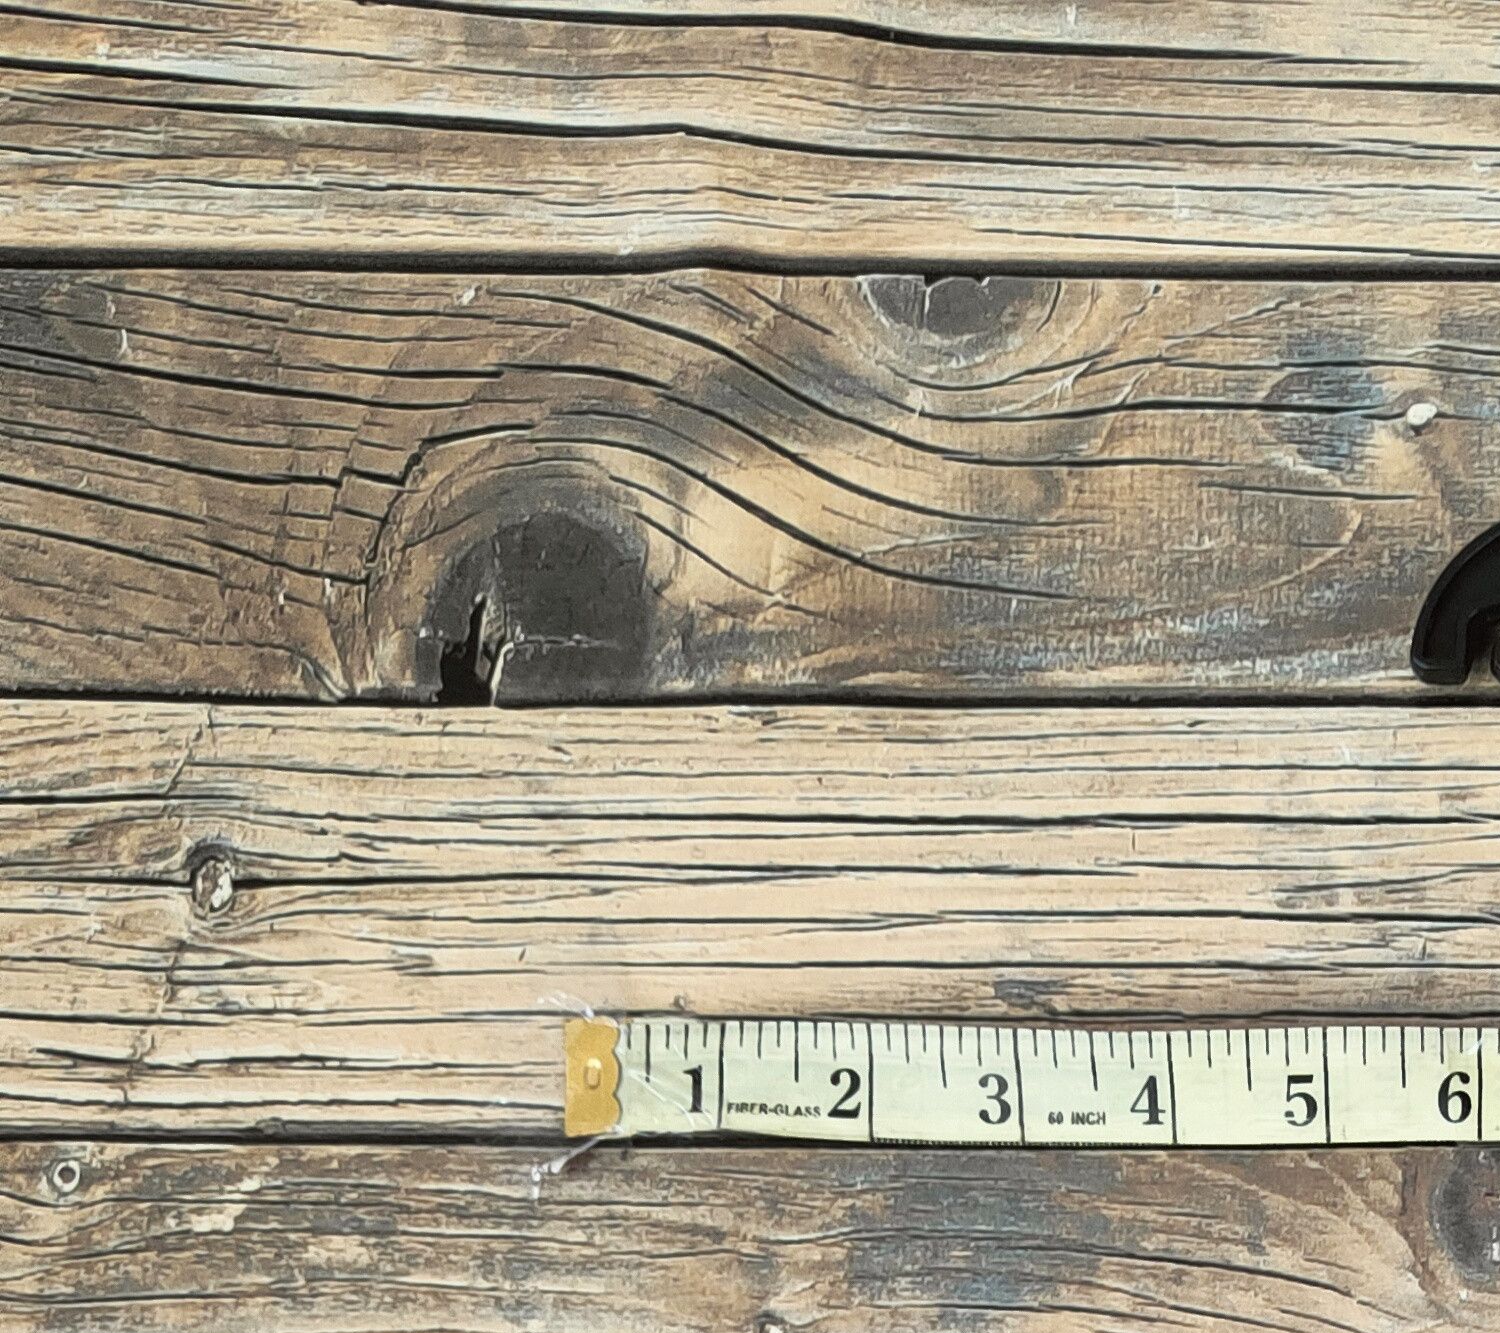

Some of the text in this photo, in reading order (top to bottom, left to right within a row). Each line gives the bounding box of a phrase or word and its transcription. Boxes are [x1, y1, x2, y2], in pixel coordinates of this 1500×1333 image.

[683, 1065, 703, 1113] 1
[827, 1068, 862, 1119] 2
[977, 1074, 1011, 1125] 3
[1130, 1075, 1167, 1125] 4
[1285, 1074, 1318, 1126] 5
[1437, 1072, 1472, 1123] 6
[1048, 1111, 1106, 1126] 60 INCH
